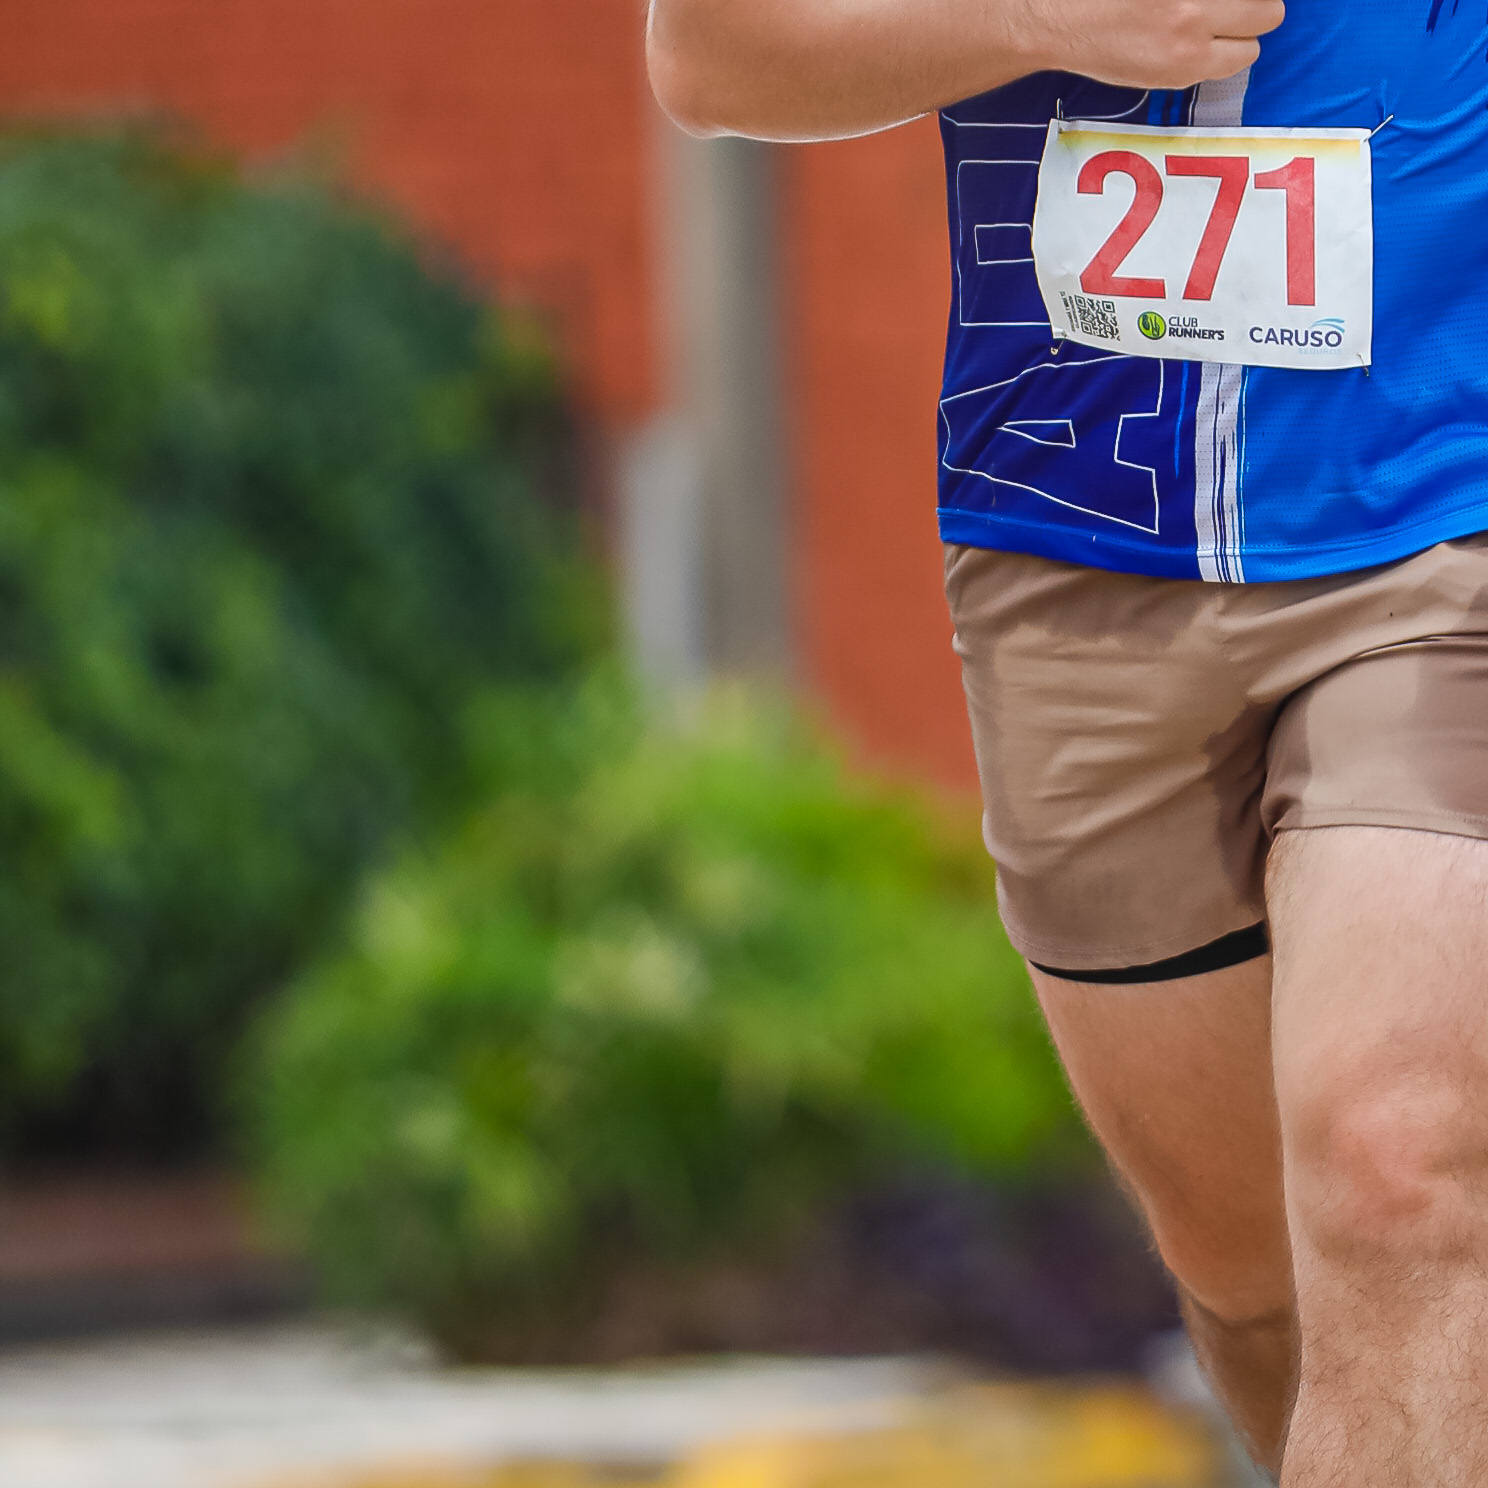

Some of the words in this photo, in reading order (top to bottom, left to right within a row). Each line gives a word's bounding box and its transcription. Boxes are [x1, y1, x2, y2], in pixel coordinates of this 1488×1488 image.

[1076, 150, 1316, 306] 271
[1168, 316, 1198, 328] CLUB
[1249, 326, 1343, 348] CARUSO
